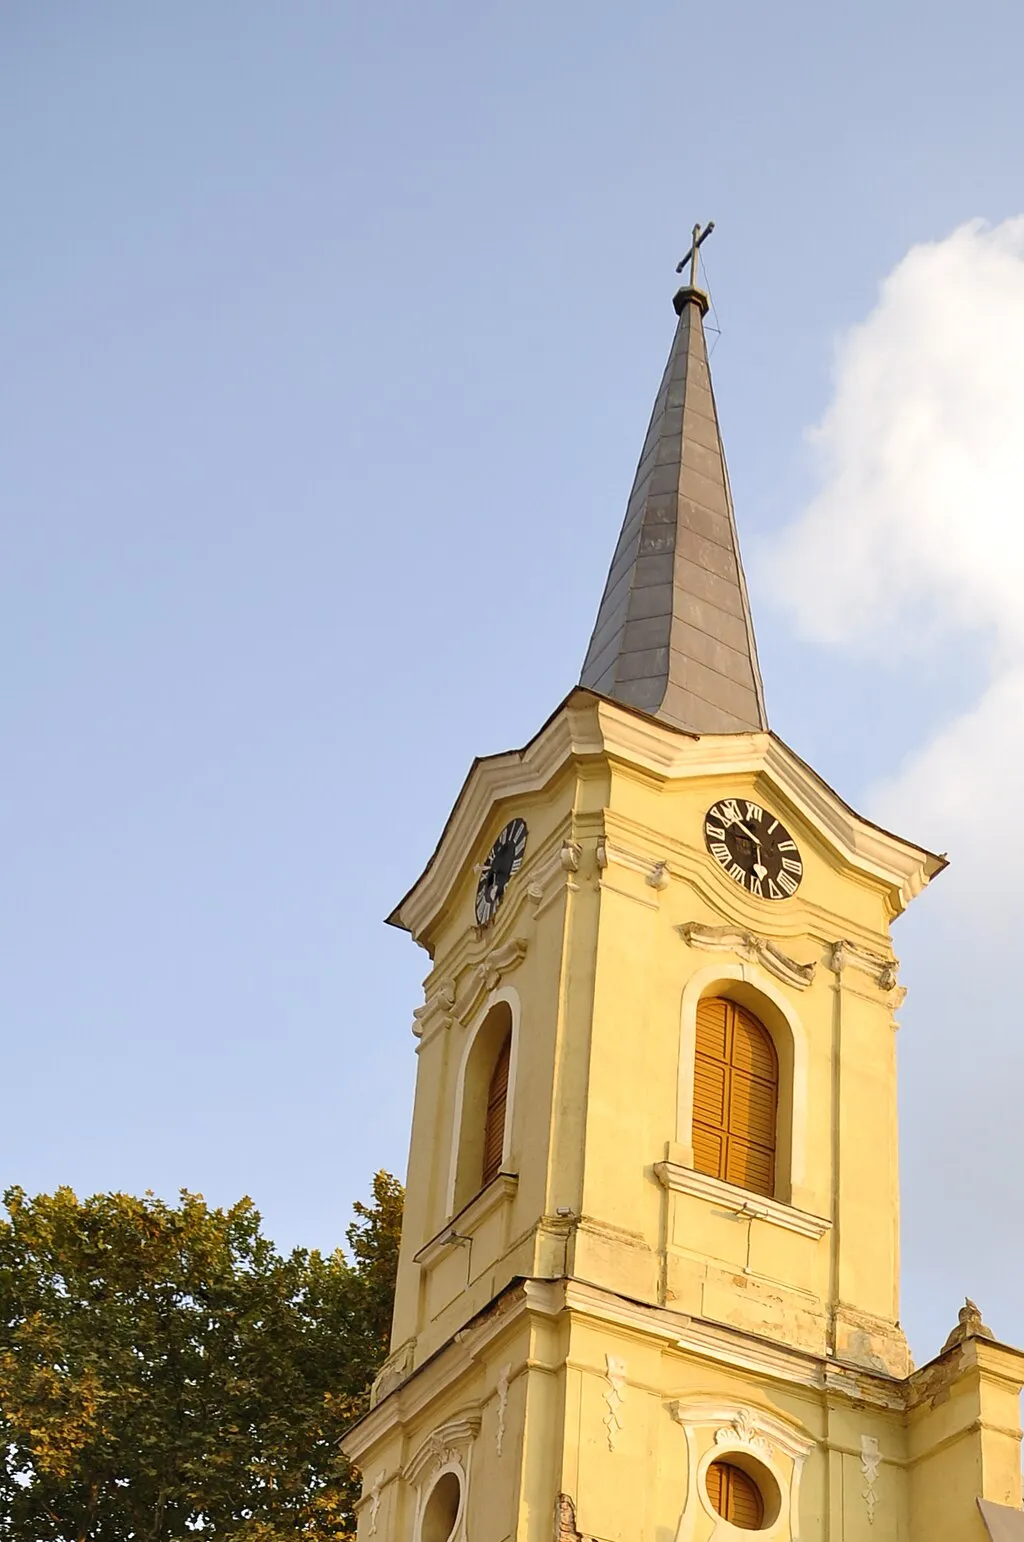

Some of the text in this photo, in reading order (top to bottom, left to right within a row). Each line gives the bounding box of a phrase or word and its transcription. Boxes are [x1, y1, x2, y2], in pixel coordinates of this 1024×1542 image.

[745, 802, 763, 822] XII
[767, 820, 779, 835] I
[777, 840, 798, 851] II
[781, 857, 802, 876] III
